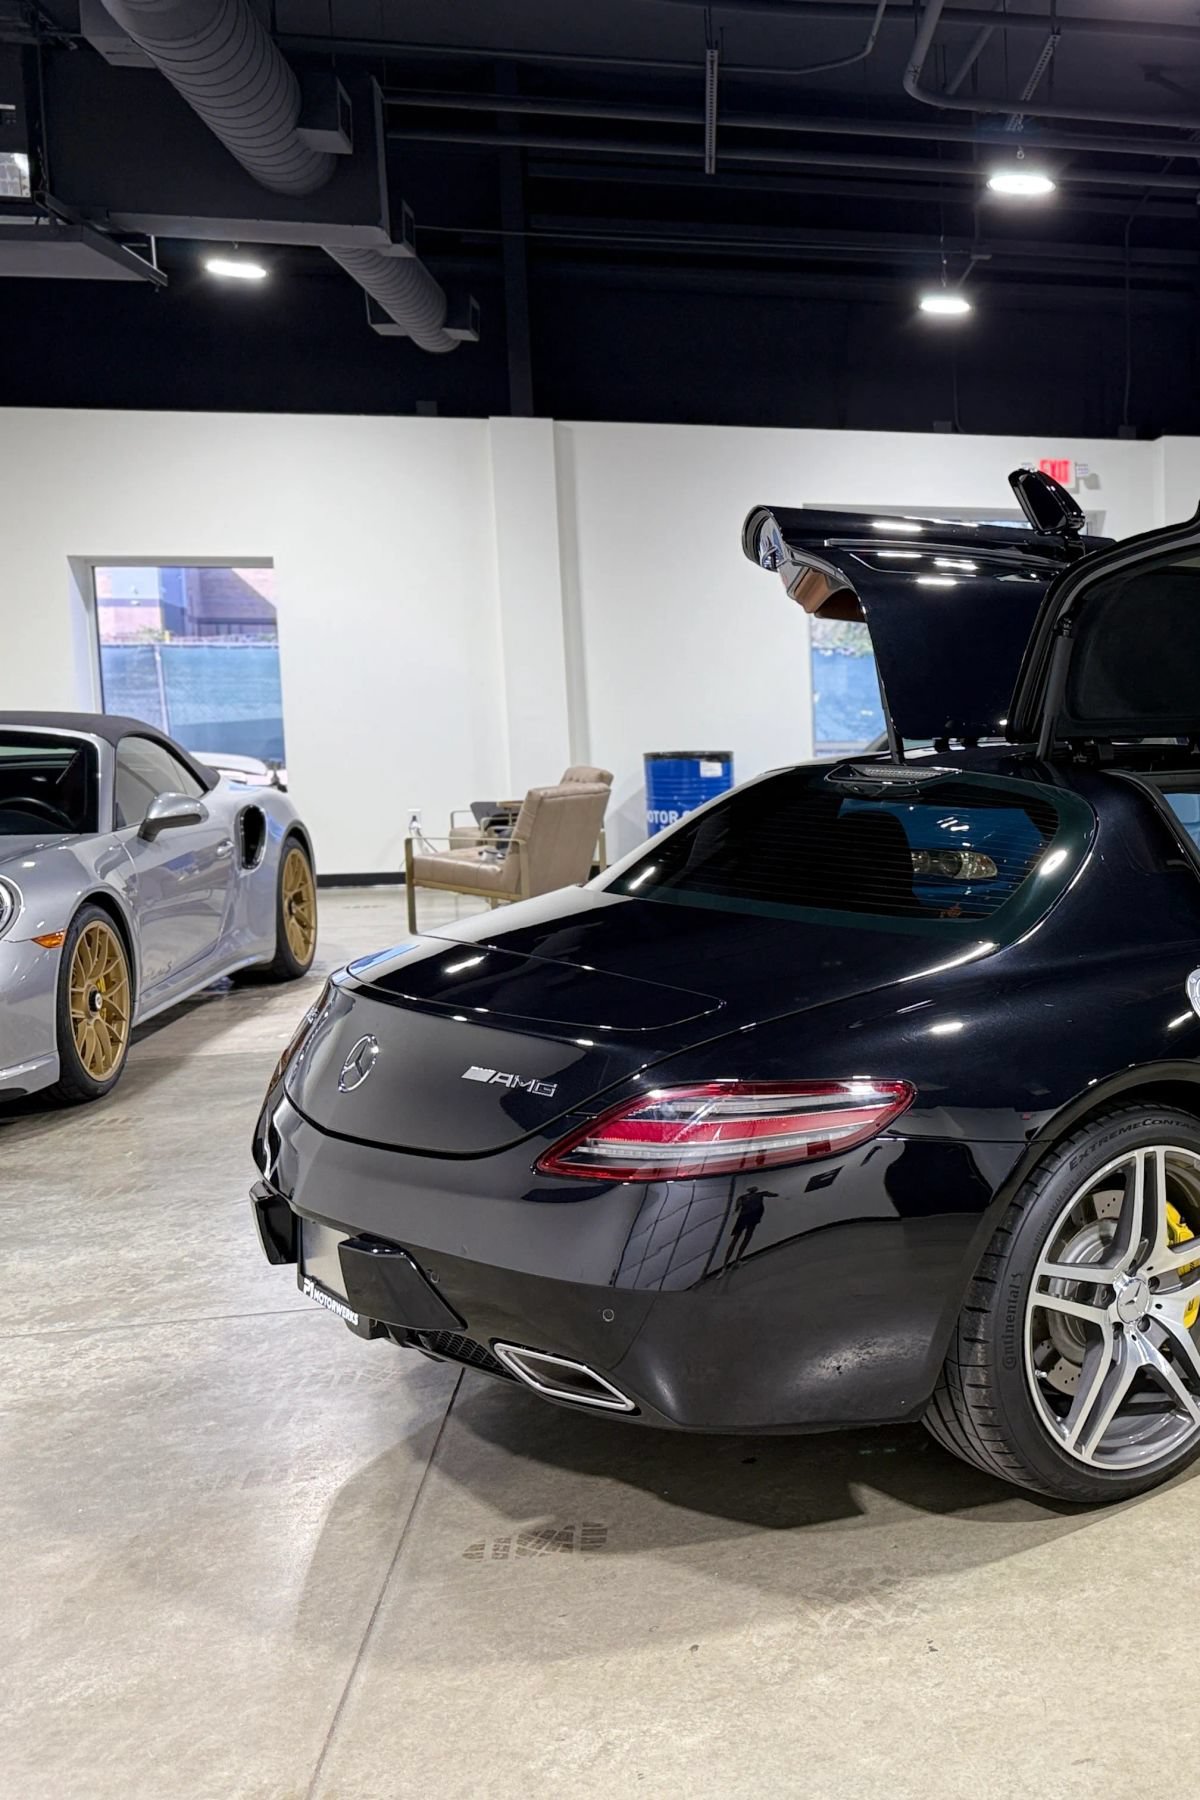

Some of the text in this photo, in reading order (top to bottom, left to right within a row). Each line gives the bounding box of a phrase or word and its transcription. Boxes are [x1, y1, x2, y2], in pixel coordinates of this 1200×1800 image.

[647, 809, 679, 825] OTOR
[489, 1071, 558, 1098] AMG
[314, 1288, 359, 1326] MOTORWERKS
